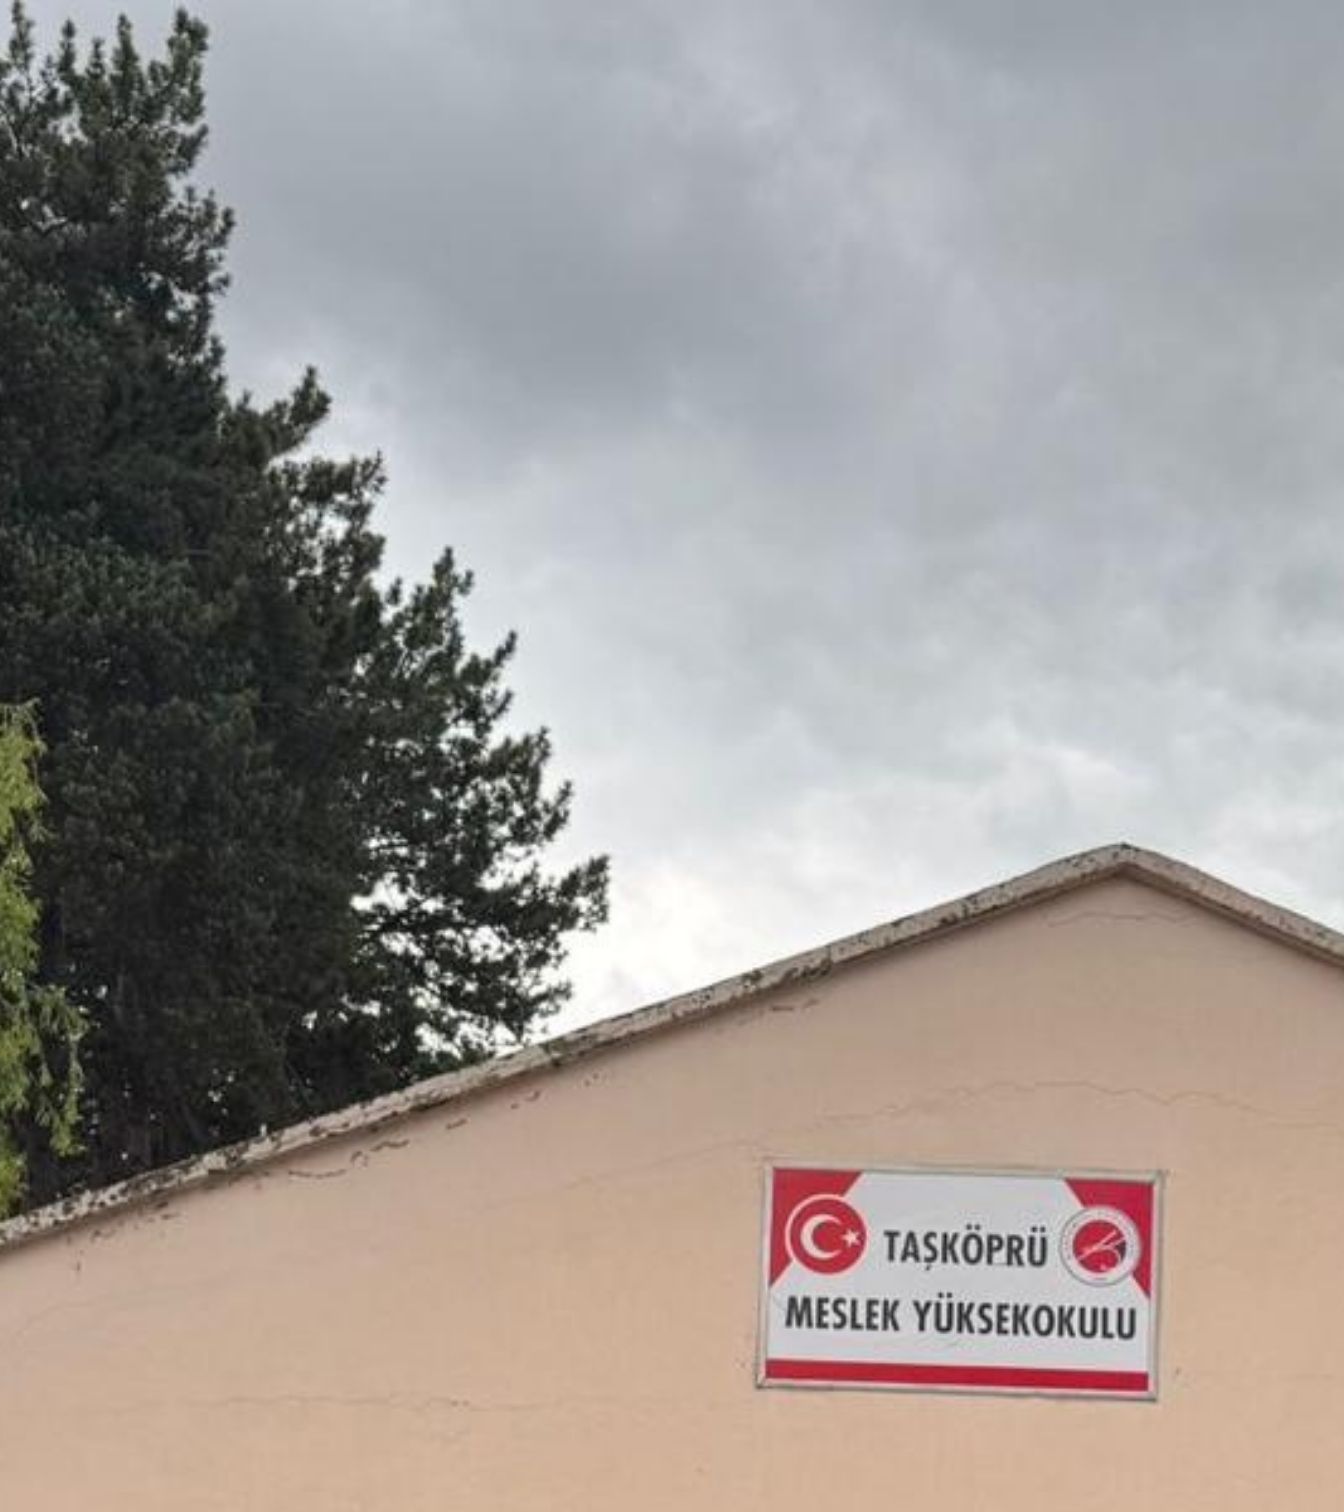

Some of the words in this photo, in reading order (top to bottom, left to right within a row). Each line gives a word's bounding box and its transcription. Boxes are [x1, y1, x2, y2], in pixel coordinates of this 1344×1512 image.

[884, 1225, 1048, 1270] TAŞKÖPRÜ
[784, 1295, 901, 1332] MESLEK
[913, 1292, 1137, 1340] YÜKSEKOKULU
